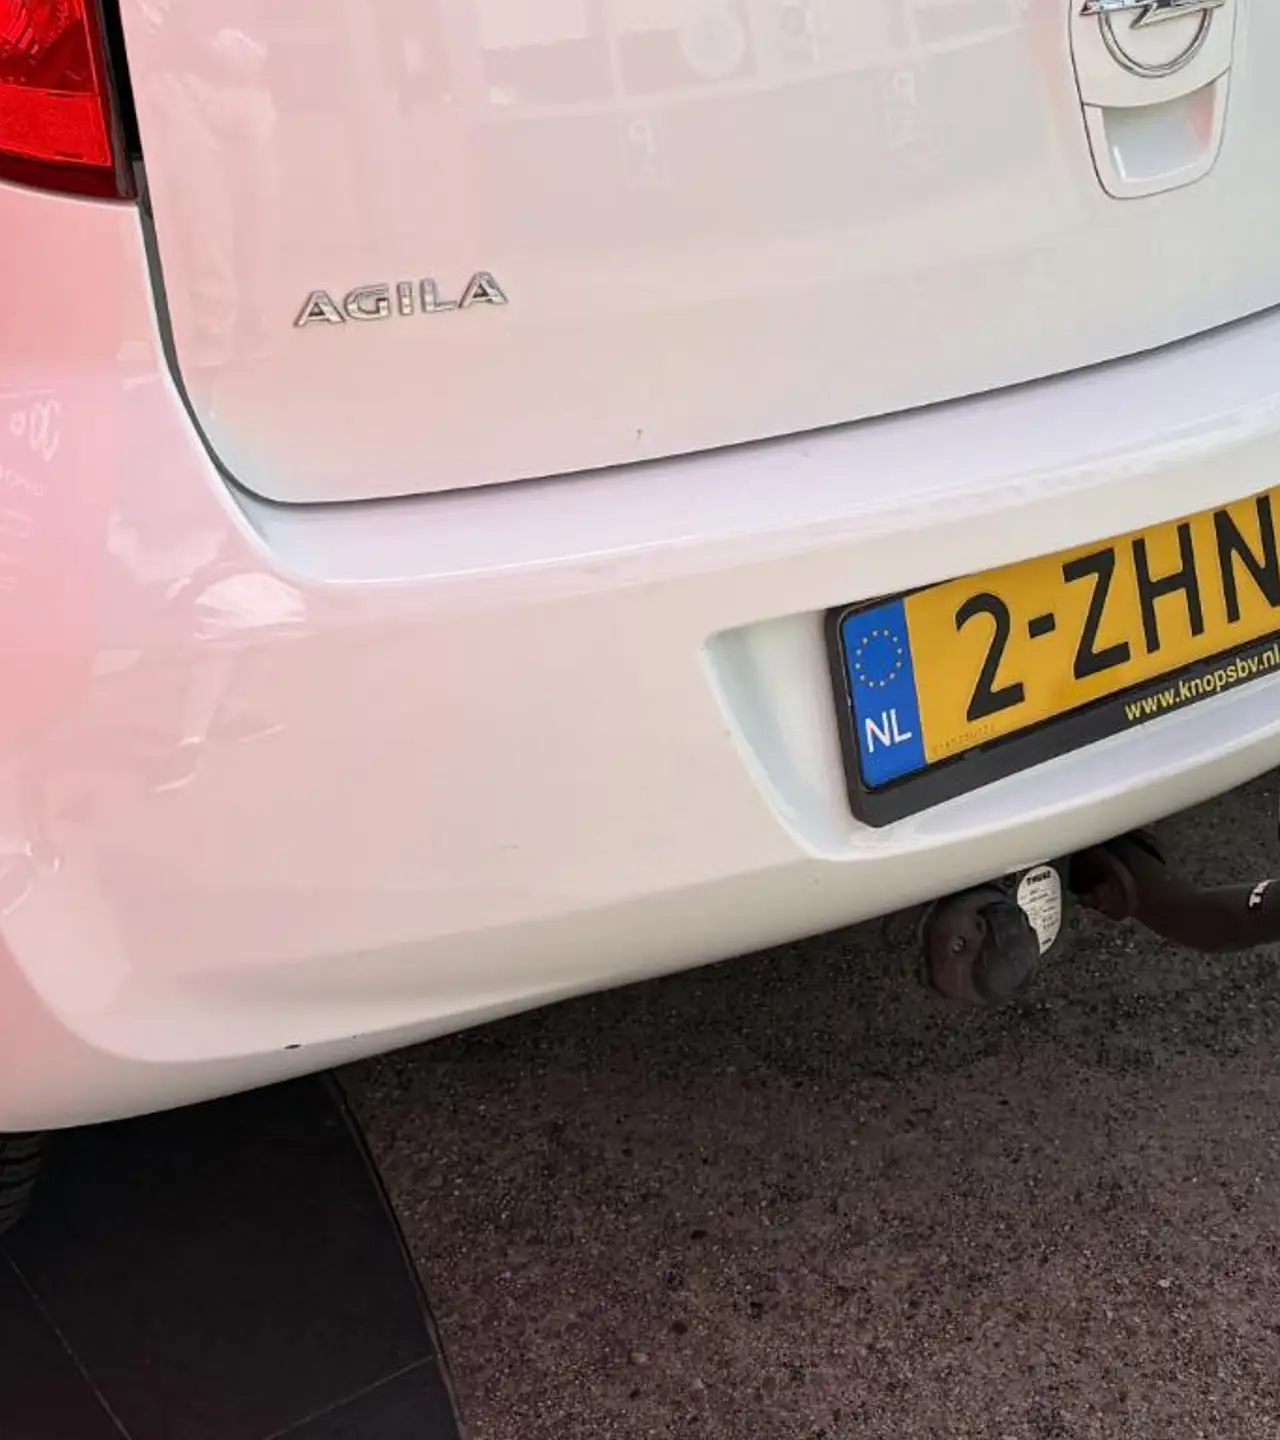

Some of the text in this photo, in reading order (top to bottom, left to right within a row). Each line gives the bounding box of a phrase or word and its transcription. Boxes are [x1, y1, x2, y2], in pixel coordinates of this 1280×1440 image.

[293, 271, 508, 329] AGILA
[1124, 644, 1280, 721] www.knopsbv.nl
[865, 709, 912, 753] NL
